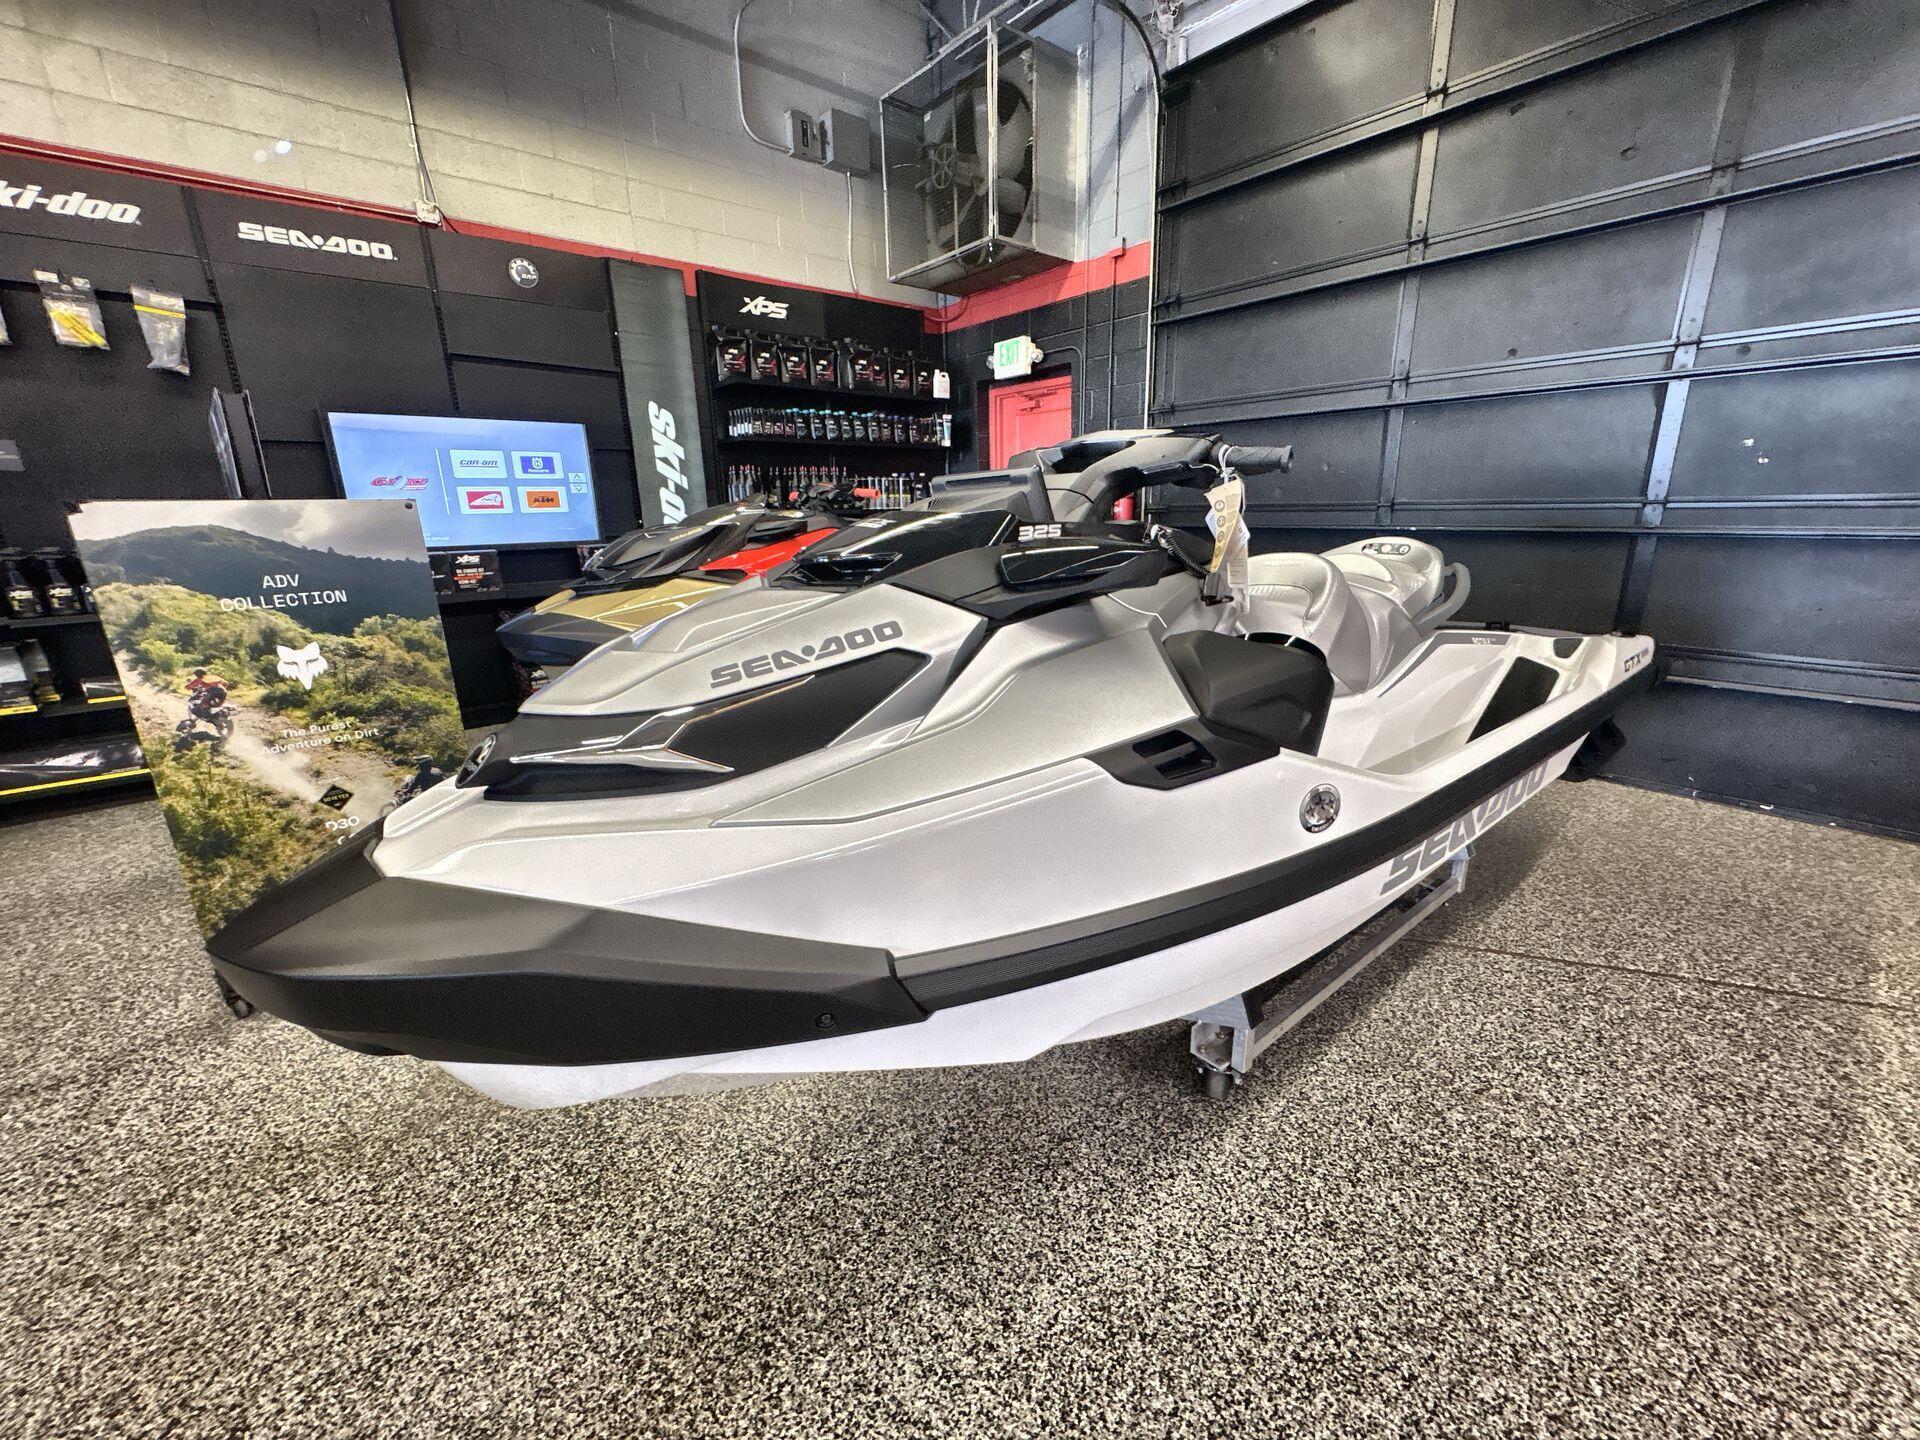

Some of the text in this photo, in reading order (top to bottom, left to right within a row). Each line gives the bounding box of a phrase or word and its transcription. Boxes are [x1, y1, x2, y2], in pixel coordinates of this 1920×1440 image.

[739, 295, 789, 319] XPS
[999, 339, 1021, 367] EXIT
[1018, 523, 1062, 542] 325
[455, 554, 480, 564] XPS
[262, 573, 299, 589] ADV
[220, 589, 347, 612] COLLECTION
[281, 720, 352, 739] The Purest
[262, 727, 380, 755] Adventure on Dirt
